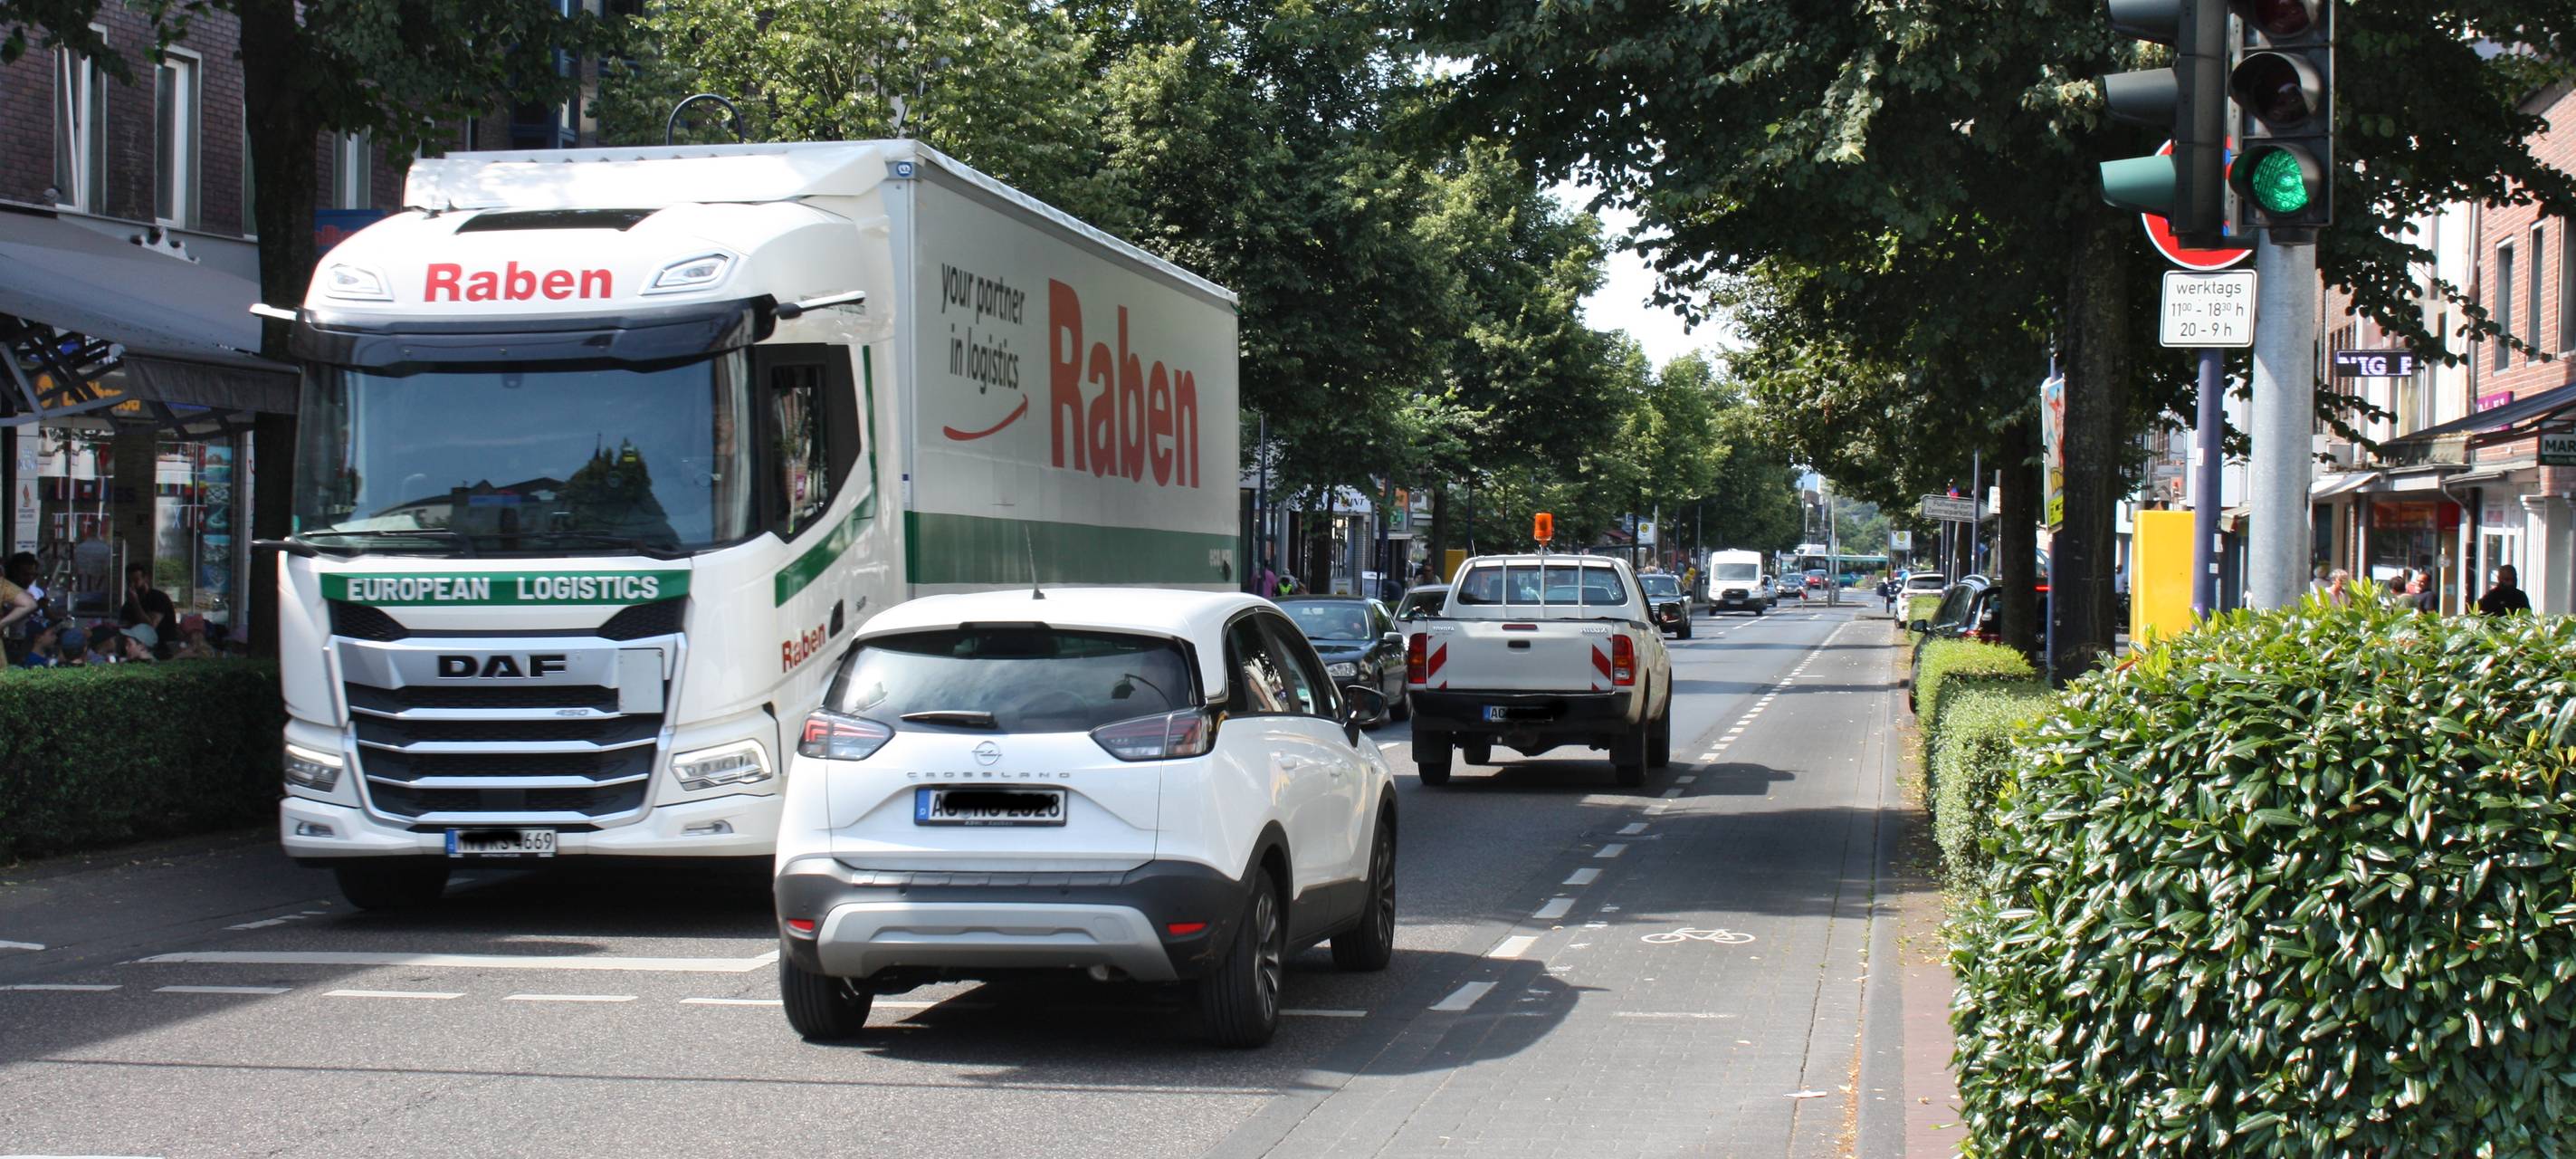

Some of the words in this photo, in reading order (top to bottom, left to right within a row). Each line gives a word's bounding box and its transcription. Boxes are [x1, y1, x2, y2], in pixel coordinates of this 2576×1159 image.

[424, 261, 613, 302] Raben
[941, 262, 974, 314] your
[975, 275, 1026, 325] partner
[2176, 281, 2242, 298] werktags
[2236, 302, 2244, 317] h
[2180, 322, 2197, 336] 20
[2211, 322, 2220, 336] 9
[2224, 322, 2233, 336] h
[949, 323, 963, 378] in
[966, 327, 1019, 394] logistics
[1048, 278, 1199, 489] Raben
[347, 576, 491, 601] EUROPEAN
[517, 575, 660, 599] LOGISTICS
[782, 622, 825, 674] Raben
[437, 654, 568, 679] DAF
[906, 771, 1071, 780] CROSSLAND
